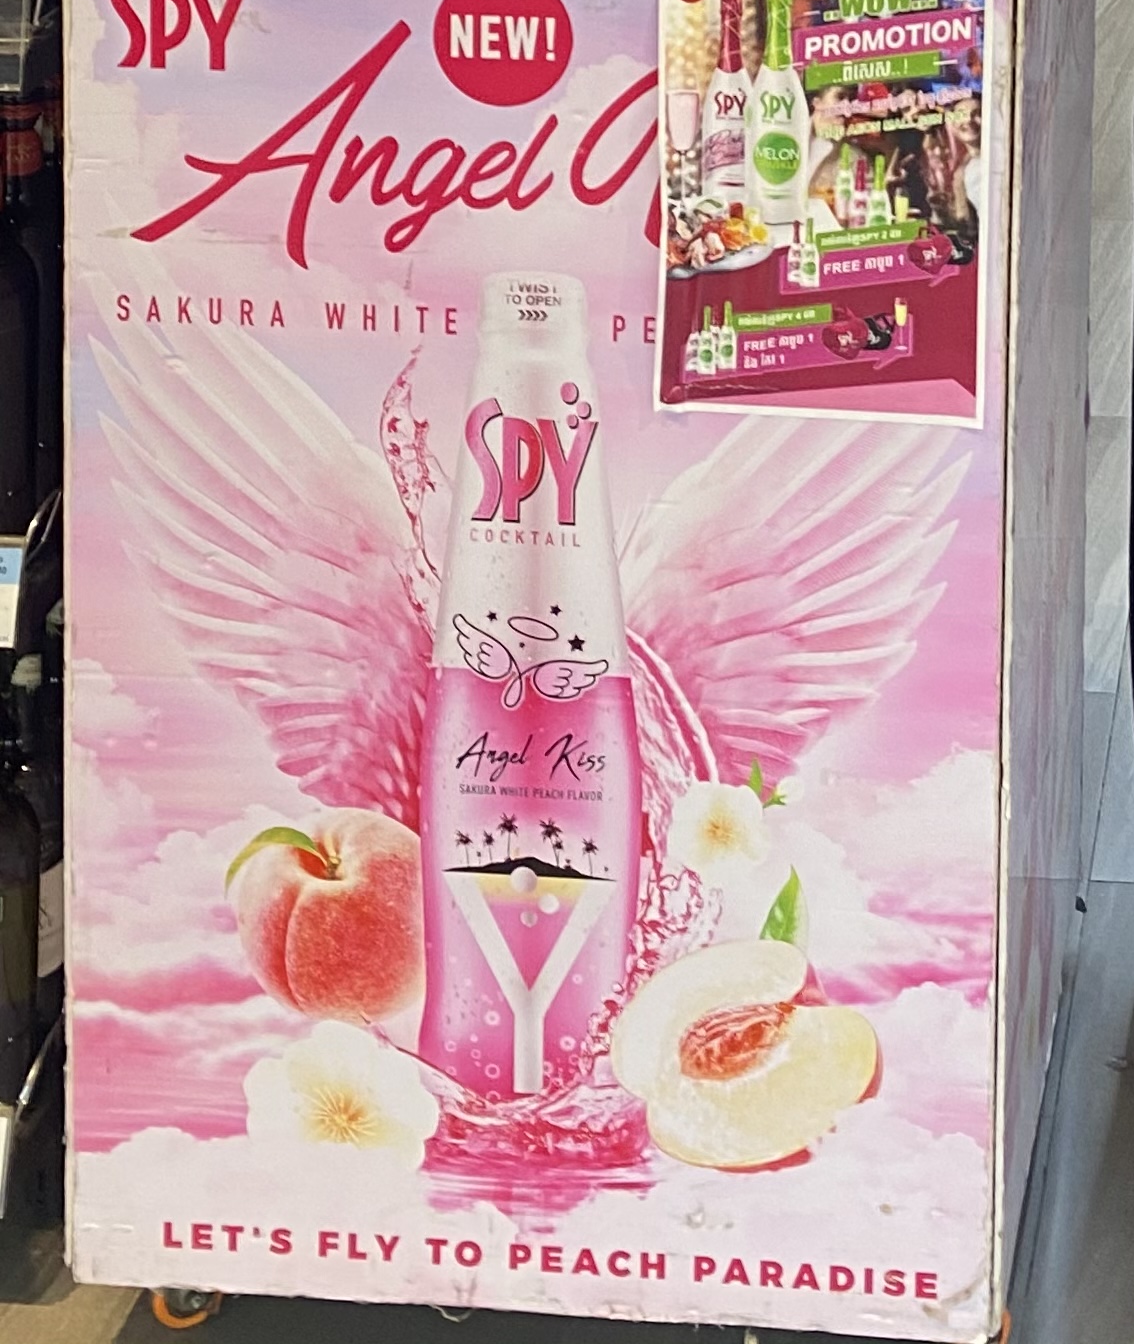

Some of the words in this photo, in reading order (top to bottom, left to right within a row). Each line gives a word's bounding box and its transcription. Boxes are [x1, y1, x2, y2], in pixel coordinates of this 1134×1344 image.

[449, 12, 557, 61] NEW!
[805, 16, 972, 60] PROMOTION
[715, 86, 747, 118] SPY
[760, 86, 796, 119] SPY
[130, 19, 558, 270] Angel
[755, 144, 800, 161] MELON
[823, 259, 861, 275] FREE
[116, 294, 285, 328] SAKURA
[325, 302, 458, 336] WHITE
[505, 294, 522, 306] TO
[525, 295, 562, 306] OPEN
[743, 337, 777, 352] FREE
[465, 382, 599, 526] SPY
[470, 529, 581, 548] COCKTAIL
[456, 731, 534, 782] Angel
[545, 733, 606, 782] Kiss
[459, 783, 497, 795] SAKURA
[500, 786, 529, 798] WHITE
[533, 787, 564, 800] PEACH
[567, 790, 603, 802] FLAVOR
[162, 1220, 293, 1255] LET'S
[318, 1231, 400, 1264] FLY
[425, 1238, 483, 1268] TO
[508, 1243, 667, 1282] PEACH
[693, 1256, 940, 1300] PARADISE
